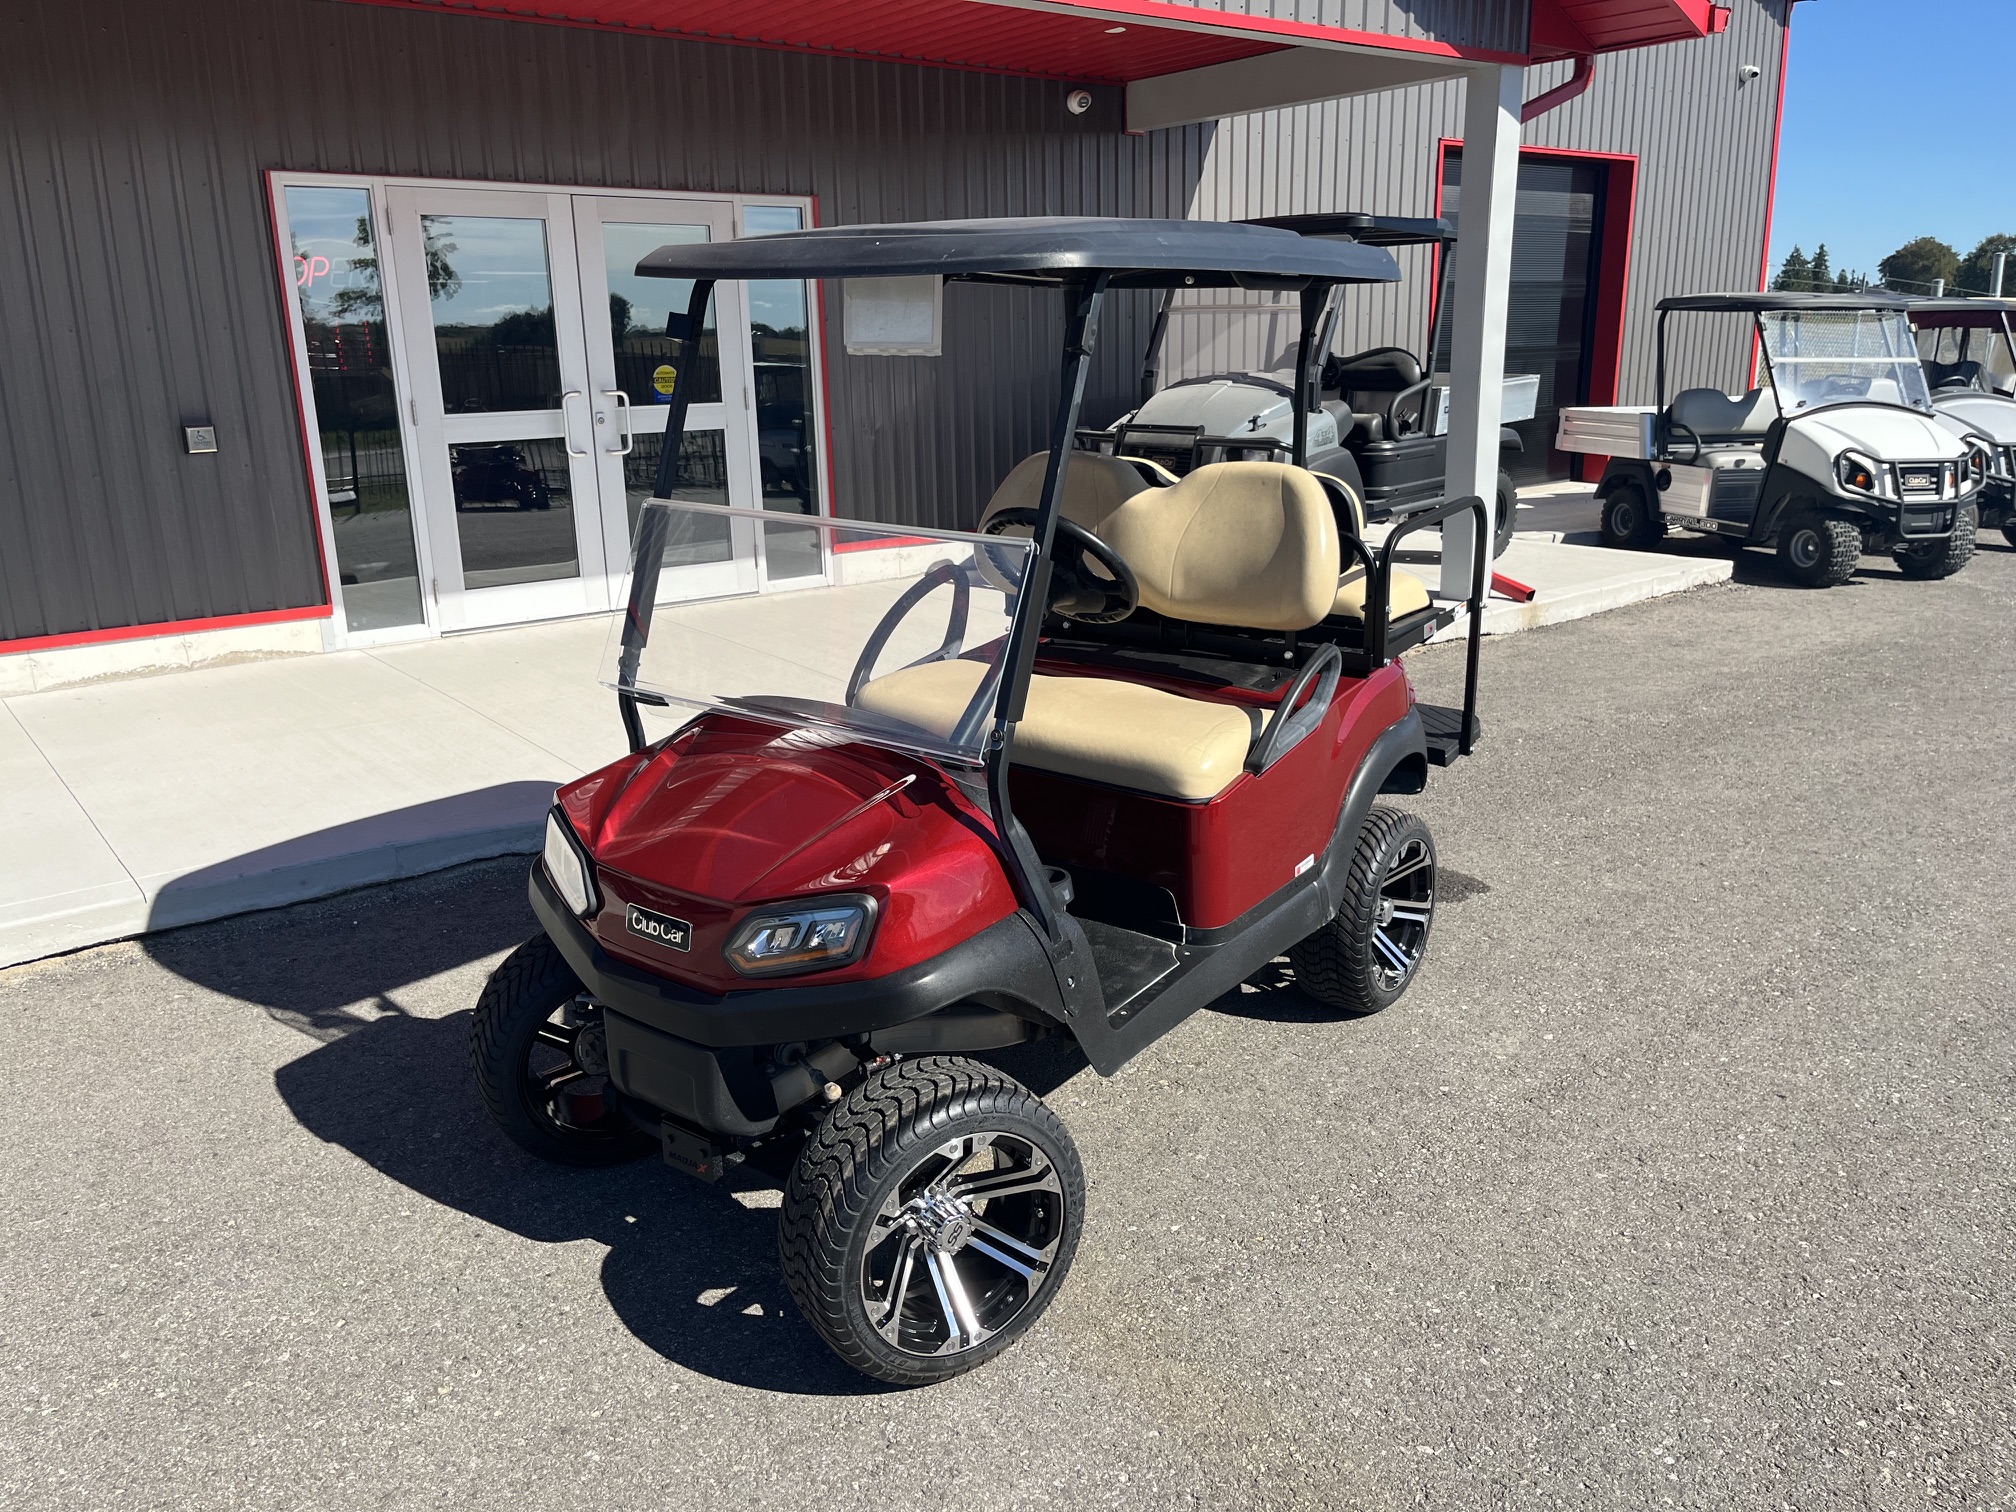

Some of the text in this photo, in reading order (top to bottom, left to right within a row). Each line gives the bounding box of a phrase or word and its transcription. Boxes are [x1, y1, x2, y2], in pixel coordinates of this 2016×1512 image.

[1665, 514, 1718, 531] CARRYALL 300
[632, 912, 684, 943] Club Car
[668, 1150, 708, 1173] MADJAX
